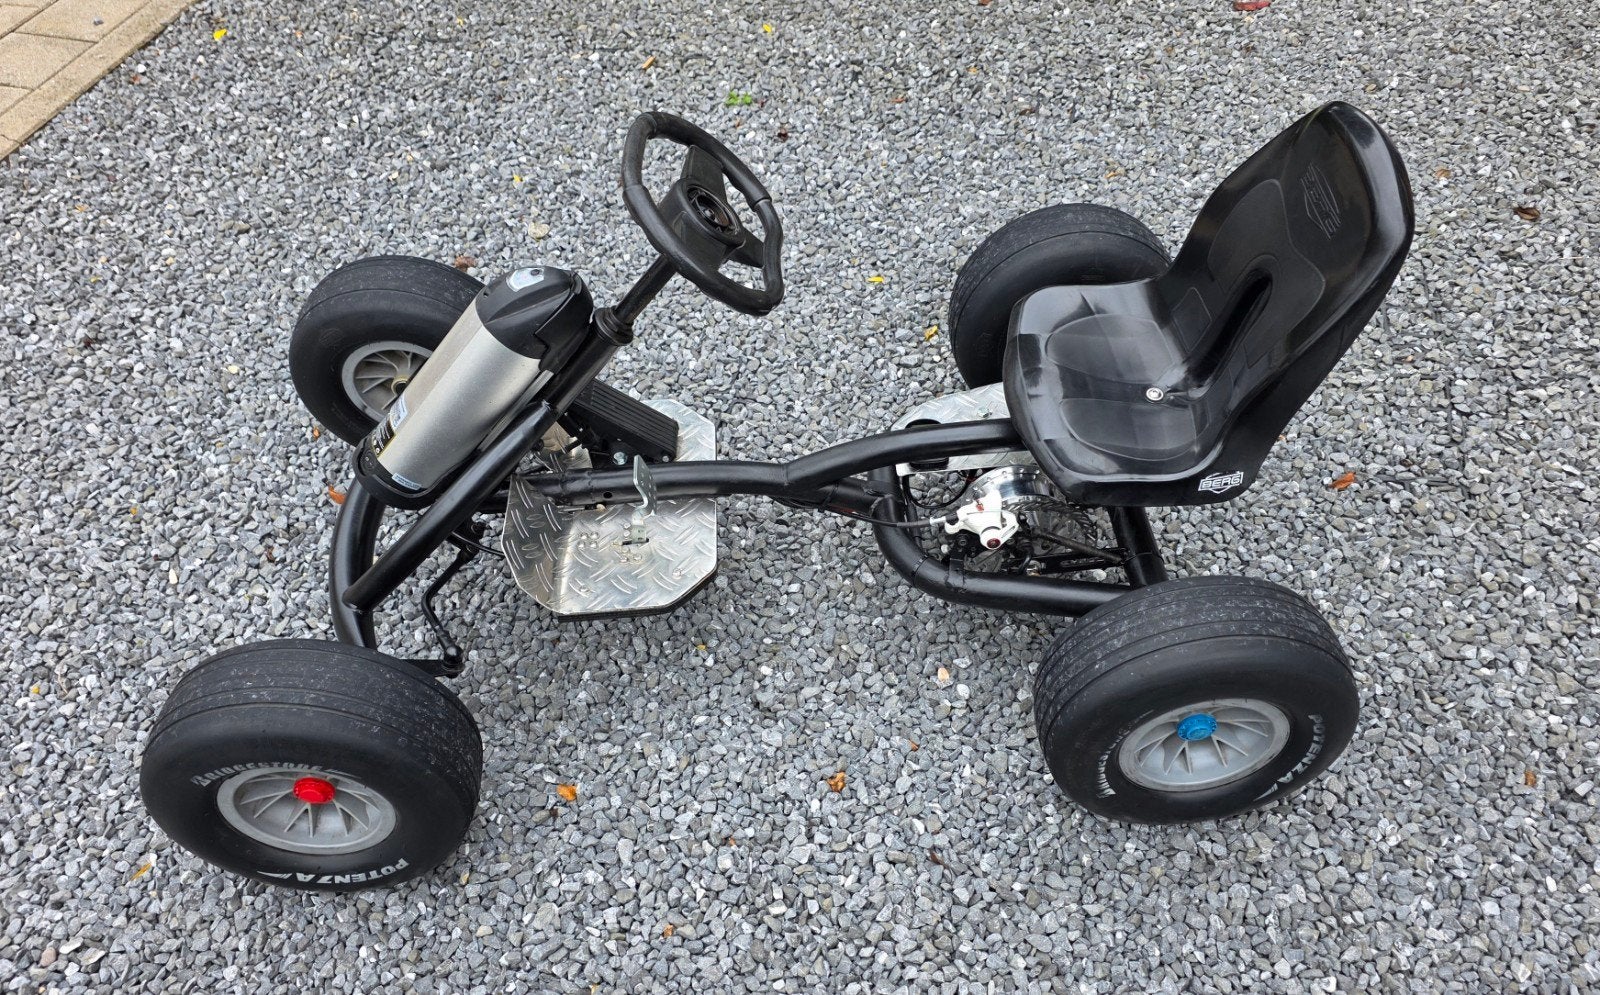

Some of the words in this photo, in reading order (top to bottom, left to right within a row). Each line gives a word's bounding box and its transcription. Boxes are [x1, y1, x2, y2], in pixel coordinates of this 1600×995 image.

[1202, 474, 1240, 488] BERG
[1276, 714, 1326, 784] POTENZA
[296, 858, 410, 884] POTENZA
